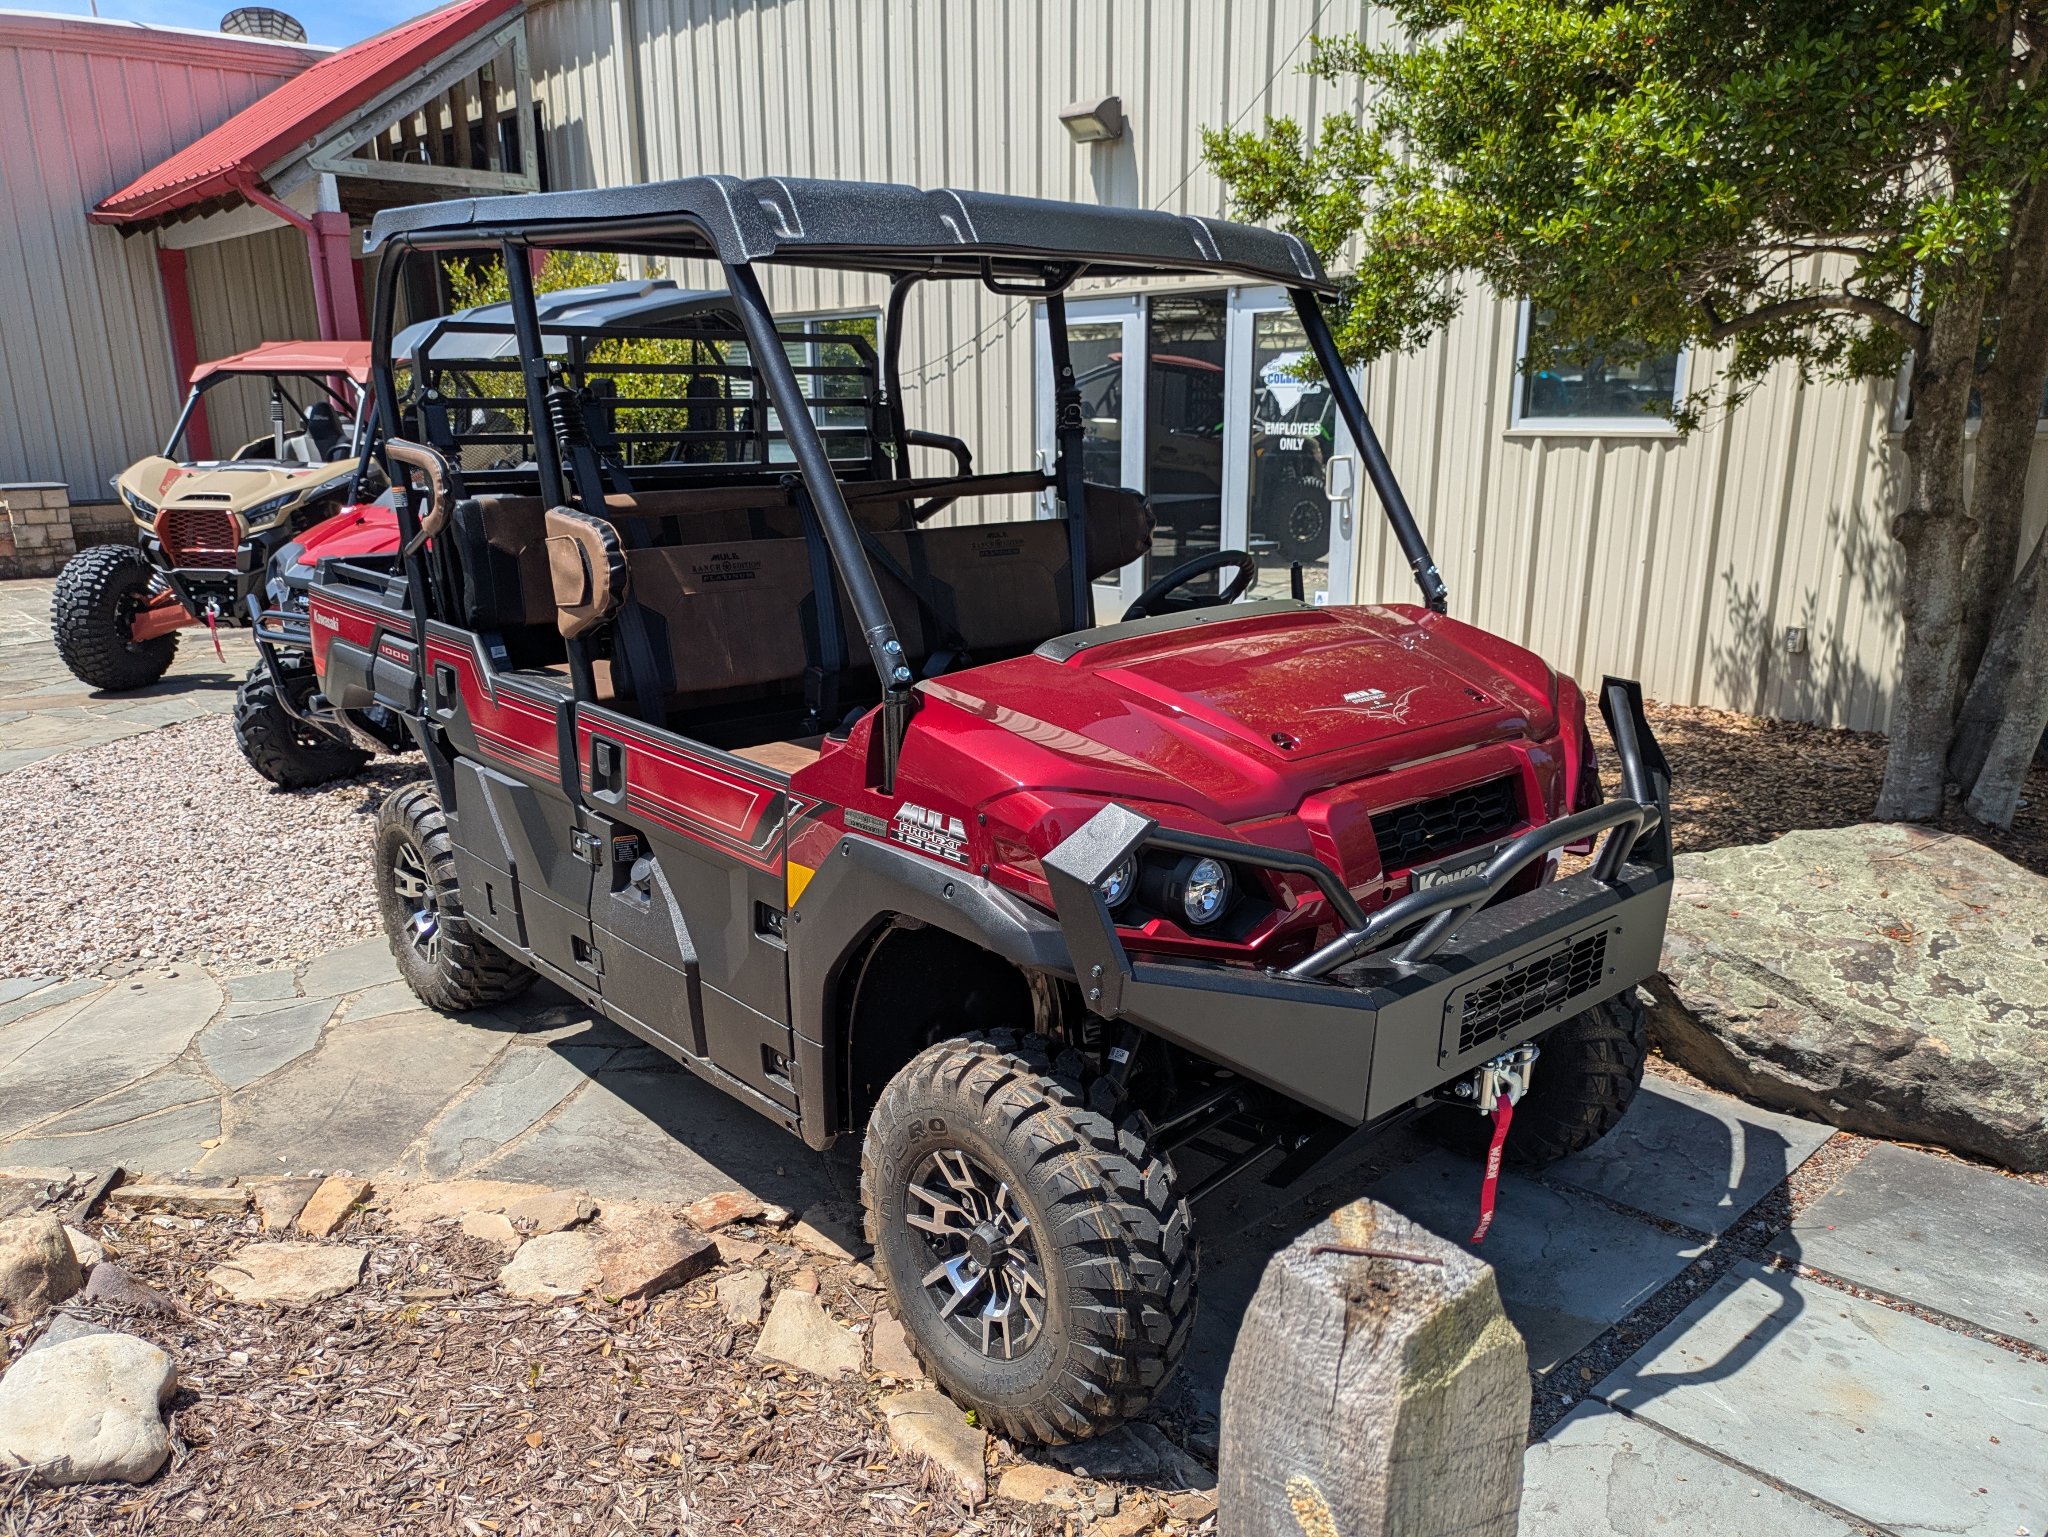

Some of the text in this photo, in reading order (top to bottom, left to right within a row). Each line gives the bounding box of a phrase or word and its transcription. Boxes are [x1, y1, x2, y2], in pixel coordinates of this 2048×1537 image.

[1264, 422, 1321, 435] EMPLOYEES
[1280, 438, 1304, 450] ONLY
[711, 552, 740, 561] MULE
[313, 608, 339, 632] Kawasaki
[381, 645, 409, 661] 1000
[893, 801, 969, 845] MULE
[897, 832, 961, 862] 1000
[1419, 861, 1488, 891] Kawas
[1486, 1144, 1502, 1180] WARN
[1472, 1210, 1493, 1239] WARN
